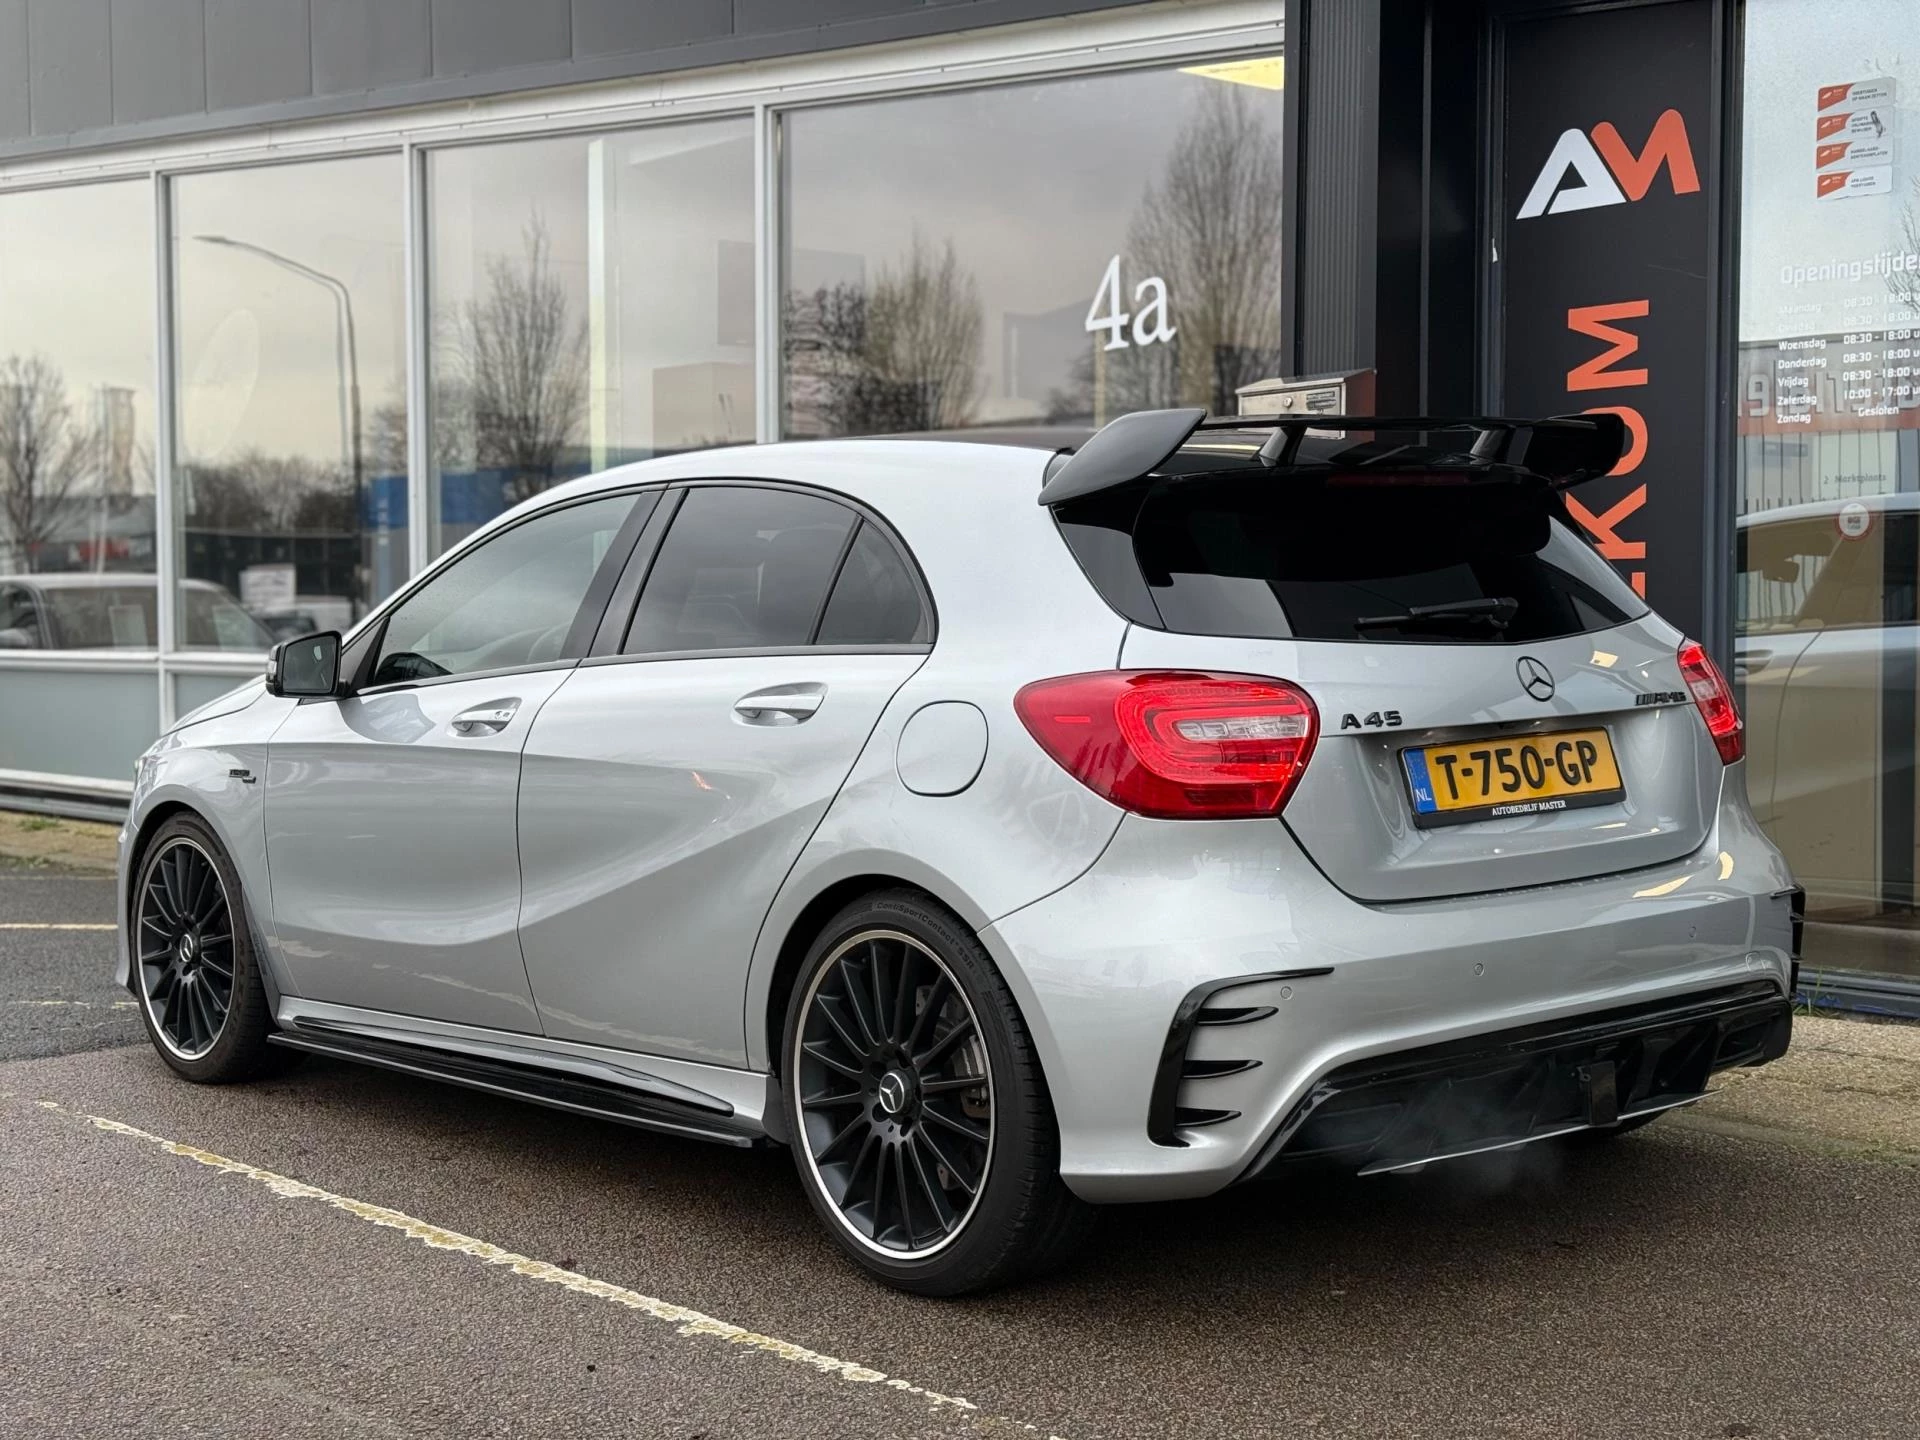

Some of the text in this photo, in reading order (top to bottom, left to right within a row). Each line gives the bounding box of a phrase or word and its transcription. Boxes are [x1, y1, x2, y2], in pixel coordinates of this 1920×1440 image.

[1515, 108, 1701, 220] AM
[1780, 251, 1920, 288] Openingstijde
[1085, 254, 1177, 351] 4a
[1779, 338, 1827, 350] Woensdag
[1844, 333, 1872, 344] 08:30
[1882, 329, 1911, 341] 18:00
[1778, 356, 1827, 369] Donderdag
[1843, 351, 1872, 363] 08:30
[1882, 348, 1911, 360] 18:00
[1777, 376, 1809, 389] Vrijdag
[1843, 370, 1872, 382] 08:30
[1882, 367, 1911, 380] 18:00
[1777, 394, 1817, 407] Zaterdag
[1843, 388, 1872, 400] 10:00
[1881, 386, 1910, 398] 17:00
[1777, 406, 1900, 424] Zondag Gesloten
[1435, 739, 1598, 801] T-750-GP
[1415, 787, 1432, 802] NL
[1492, 799, 1567, 816] AUTOBEDRIJF MASTER
